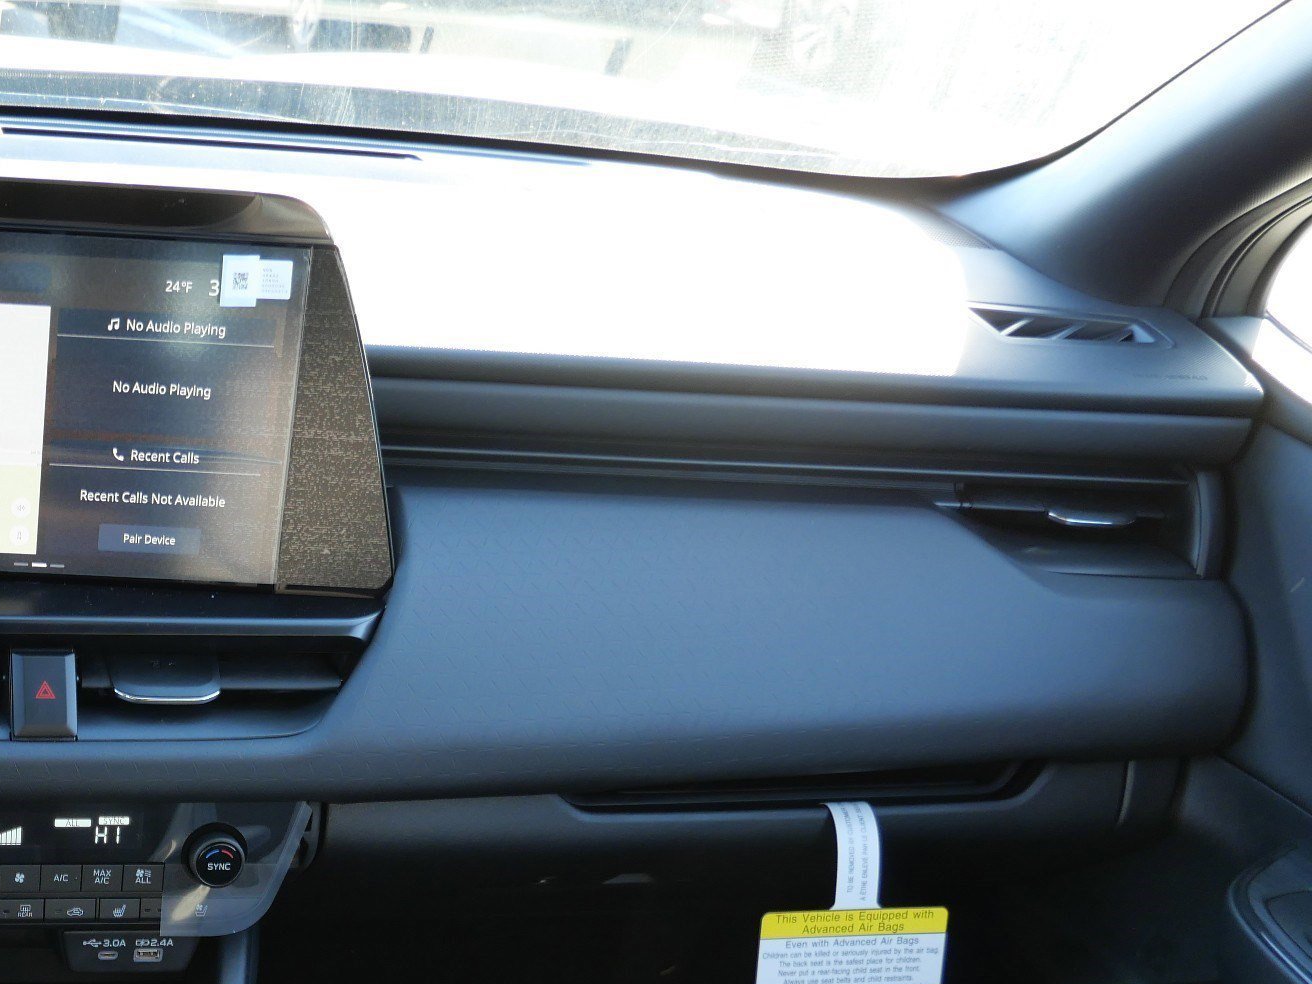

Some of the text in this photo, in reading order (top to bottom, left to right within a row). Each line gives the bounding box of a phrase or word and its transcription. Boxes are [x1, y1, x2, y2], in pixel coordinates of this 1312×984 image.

[165, 280, 193, 293] 24°F
[126, 319, 226, 339] No Audio Playing
[112, 381, 211, 400] No Audio Playing
[130, 449, 200, 464] Recent Calls
[80, 489, 226, 508] Recent Calls Not Available
[123, 533, 176, 545] Pair Device
[94, 826, 121, 844] HI
[207, 862, 231, 871] SYNC
[53, 874, 69, 882] A/C
[93, 869, 111, 877] MAX
[94, 876, 110, 885] A/C
[135, 876, 151, 884] ALL
[775, 909, 934, 924] This Vehicle is Equipped with
[802, 922, 905, 934] Advanced Air Bags
[102, 939, 126, 947] 3.0A
[150, 939, 173, 947] 2.4A
[785, 936, 919, 949] Even with Advanced Air Bags
[762, 951, 788, 960] Children
[803, 950, 812, 958] be
